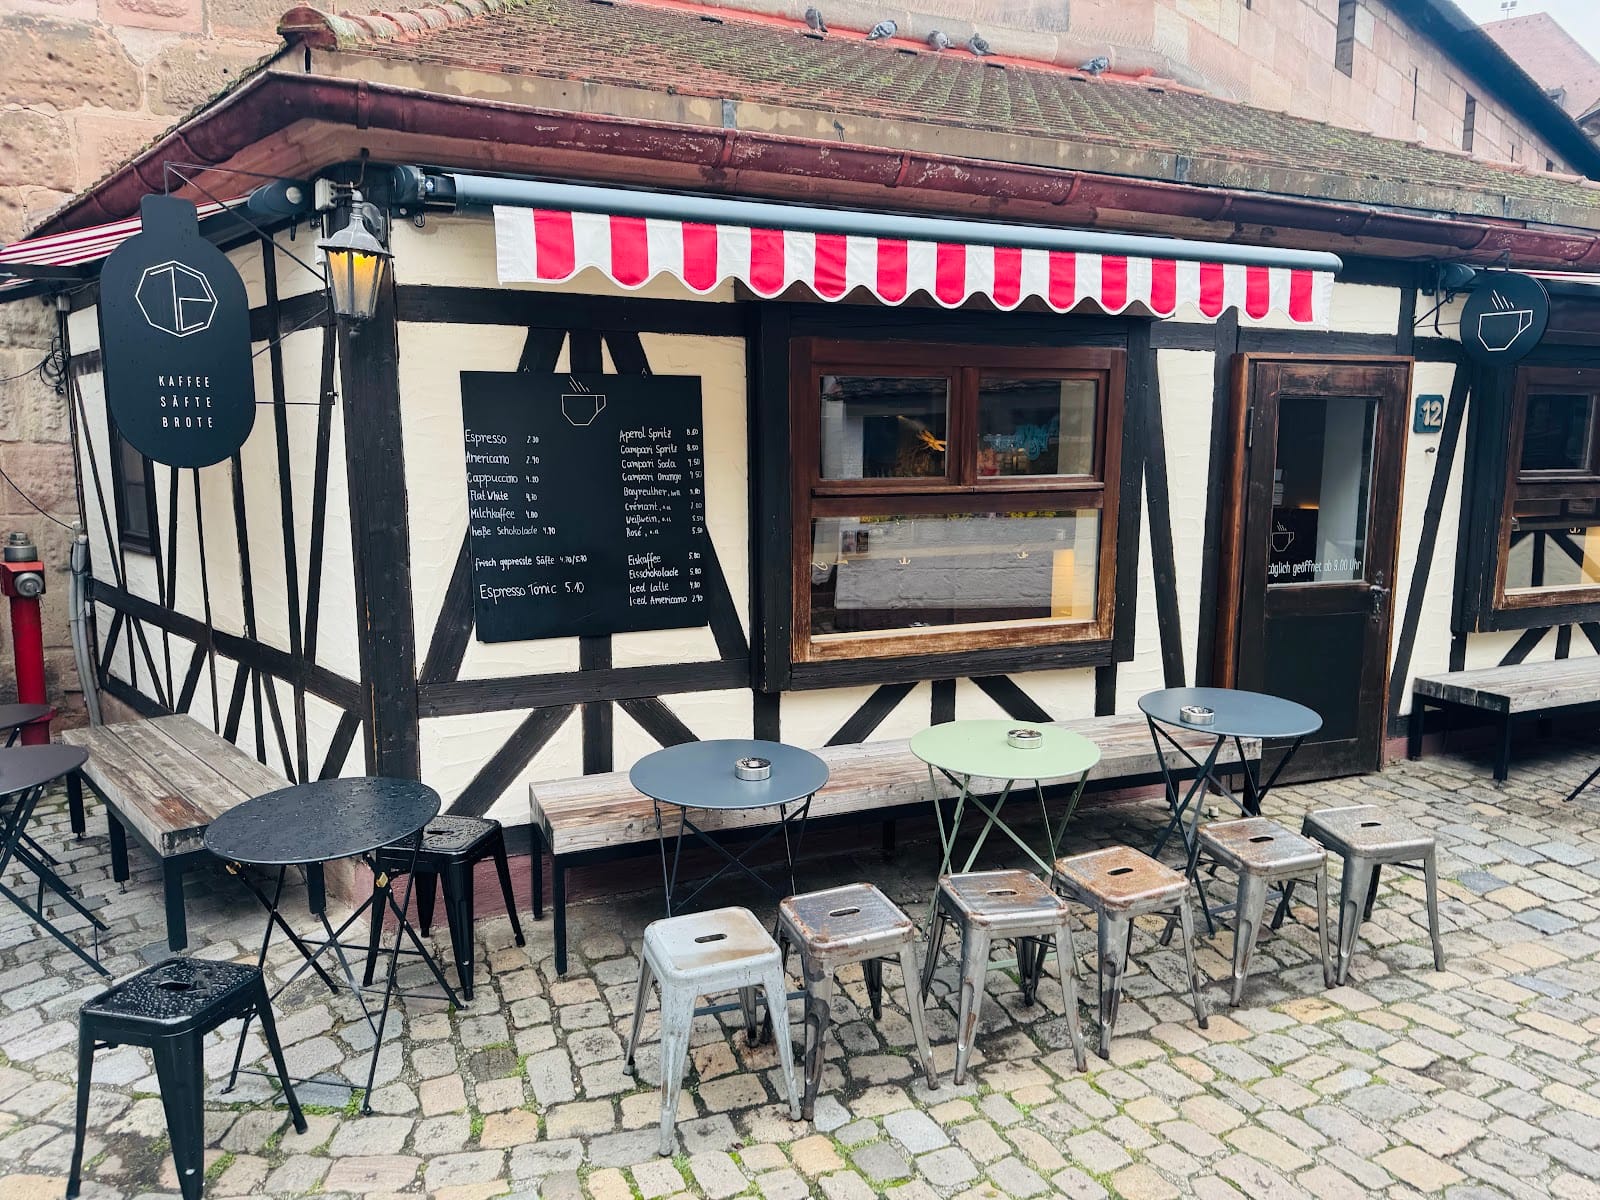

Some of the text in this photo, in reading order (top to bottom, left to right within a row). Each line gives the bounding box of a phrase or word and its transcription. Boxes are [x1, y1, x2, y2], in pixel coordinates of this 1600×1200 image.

[158, 375, 211, 388] KAFFEE
[160, 395, 213, 408] SÄFTE
[1421, 400, 1442, 426] 12
[162, 417, 214, 428] BROTE
[465, 429, 507, 447] Espresso
[619, 426, 647, 443] Aperol
[648, 427, 672, 441] Spritz
[620, 445, 653, 457] Campari
[655, 443, 678, 457] Spritz
[466, 451, 510, 464] Americano
[621, 459, 654, 471] Campari
[657, 459, 677, 468] Soda
[467, 472, 519, 488] Cappuccino
[621, 473, 654, 484] Campari
[657, 473, 682, 483] Orange
[469, 490, 486, 500] Flat
[486, 490, 509, 501] White
[470, 507, 516, 522] Milchkaffee
[471, 525, 492, 538] heiße
[496, 525, 538, 536] Schokolade
[475, 557, 497, 571] frisch
[499, 555, 533, 571] gepresste
[535, 555, 556, 566] Säfte
[627, 552, 662, 570] Eiskaffee
[1292, 559, 1322, 576] geöffnet
[1350, 558, 1362, 571] Uhr
[628, 566, 679, 580] Eisschokolade
[479, 581, 585, 605] Espresso Tonic 5.10
[629, 582, 646, 593] Iced
[650, 595, 688, 605] Americano
